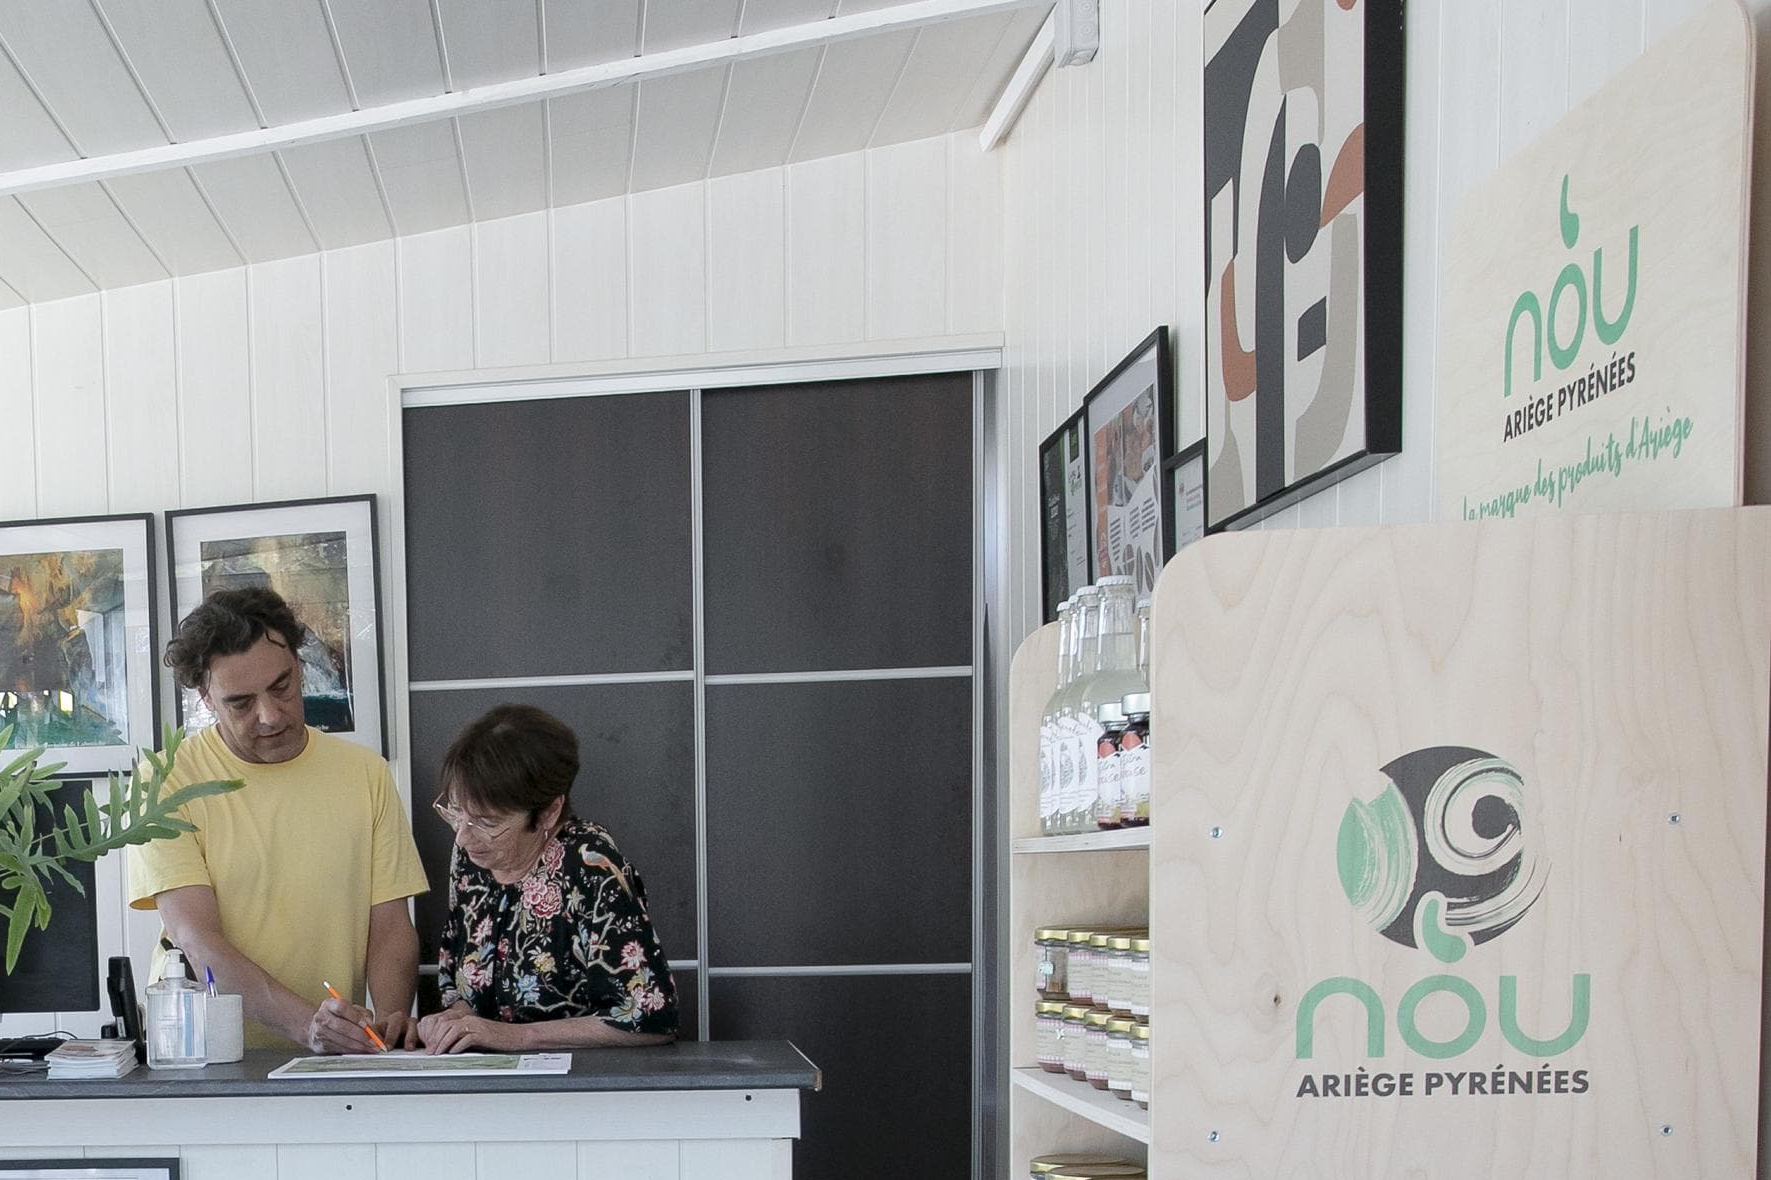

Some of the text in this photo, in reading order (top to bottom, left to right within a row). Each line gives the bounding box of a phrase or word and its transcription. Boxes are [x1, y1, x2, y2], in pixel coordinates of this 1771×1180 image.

[1503, 351, 1636, 442] ARIÈGE PYRÉNÉES
[1534, 458, 1556, 503] des
[1558, 432, 1623, 508] produits
[1625, 405, 1694, 461] d'Ariège
[1295, 1063, 1590, 1098] ARIÈGE PYRÉNÉES
